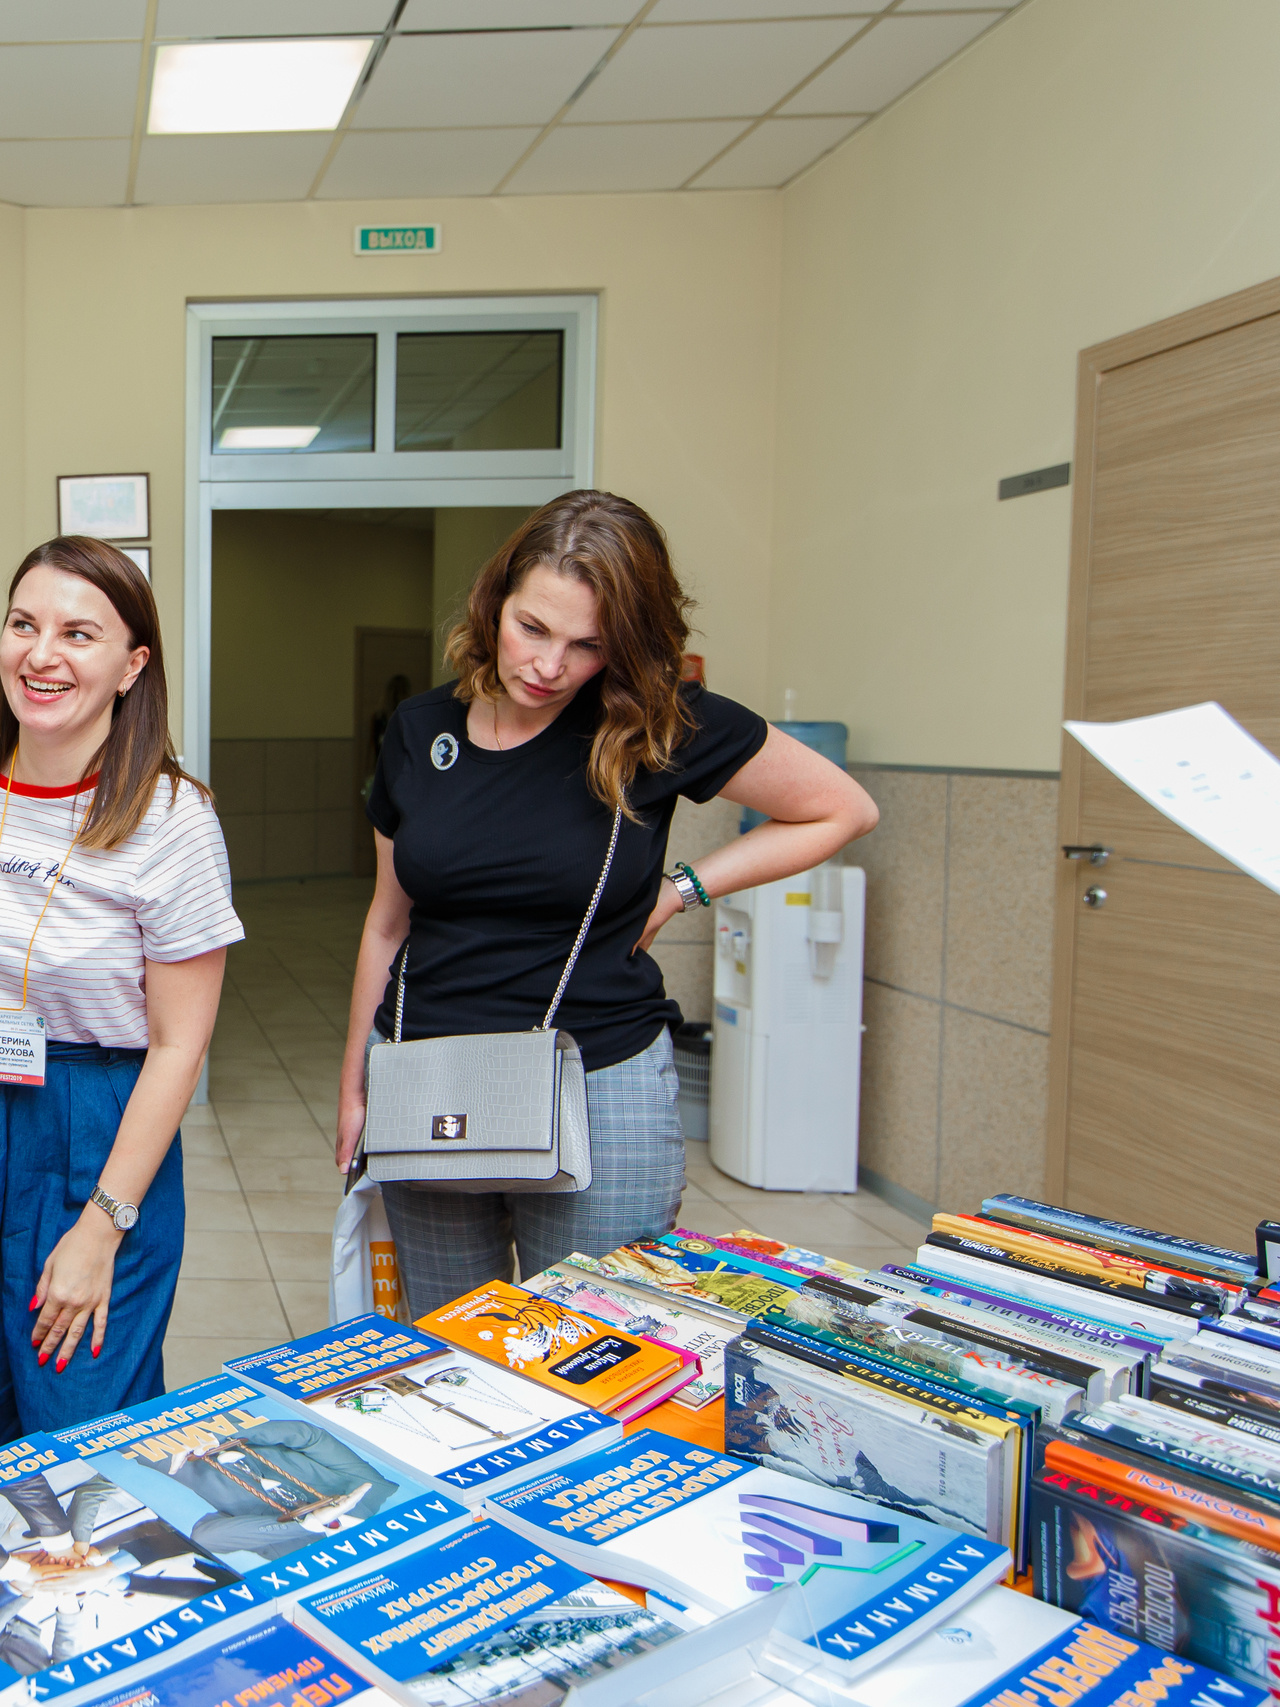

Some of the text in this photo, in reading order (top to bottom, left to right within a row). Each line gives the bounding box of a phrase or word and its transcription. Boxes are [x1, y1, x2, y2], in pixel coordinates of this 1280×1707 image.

[368, 230, 427, 249] ВЫХОД
[1170, 1237, 1252, 1261] БЕРЛИНЕ
[435, 1291, 490, 1324] принцессы
[458, 1298, 504, 1324] Дикари
[735, 1286, 788, 1316] ПРОСВЕ
[360, 1332, 413, 1356] ПРИ
[802, 1336, 823, 1347] Кук
[982, 1319, 1011, 1332] ТЕБЯ
[1012, 1329, 1054, 1346] МНОГО
[984, 1303, 1118, 1349] ЛИТВИНОВЫ
[1050, 1313, 1126, 1341] НА НЕГО
[266, 1328, 385, 1374] БЮДЖЕТЕ
[273, 1349, 366, 1385] МАЛОМ
[297, 1341, 431, 1393] МАРКЕТИНГ
[554, 1336, 623, 1377] Кати Ершовой
[583, 1350, 622, 1373] Школа
[833, 1336, 960, 1385] КОРОЛЕВСТВО
[1210, 1353, 1272, 1375] НИКОЛСОН
[838, 1350, 986, 1407] ПОЛНОЧНОЕ СОЛНЦЕ
[844, 1363, 959, 1409] СПЛЕТЕНИЕ
[72, 1385, 258, 1457] МЕНЕДЖМЕНТ
[121, 1407, 270, 1463] ТАЙМ-
[1136, 1434, 1167, 1451] ЗА
[446, 1413, 602, 1485] АЛЬМАНАХ
[684, 1449, 716, 1464] В
[541, 1449, 671, 1509] КРИЗИСА
[548, 1459, 696, 1532] УСЛОВИЯХ
[584, 1459, 743, 1541] МАРКЕТИНГ
[1043, 1472, 1165, 1524] ДАЛЬ
[1125, 1469, 1268, 1528] ПОЛЯКОВА
[261, 1499, 449, 1590] АЛЬМАНАХ
[534, 1553, 557, 1569] В
[360, 1558, 542, 1657] ГОСУДАРСТВЕННЫХ
[376, 1556, 497, 1620] СТРУКТУРАХ
[826, 1544, 985, 1653] АЛЬМАНАХ
[1108, 1568, 1141, 1637] РАСЧЕТ
[28, 1584, 255, 1698] АЛЬМАНАХ
[419, 1581, 555, 1658] МЕНЕДЖМЕНТ
[233, 1656, 325, 1707] ПРИЕМЫ
[1104, 1656, 1196, 1707] ЭФФЕ
